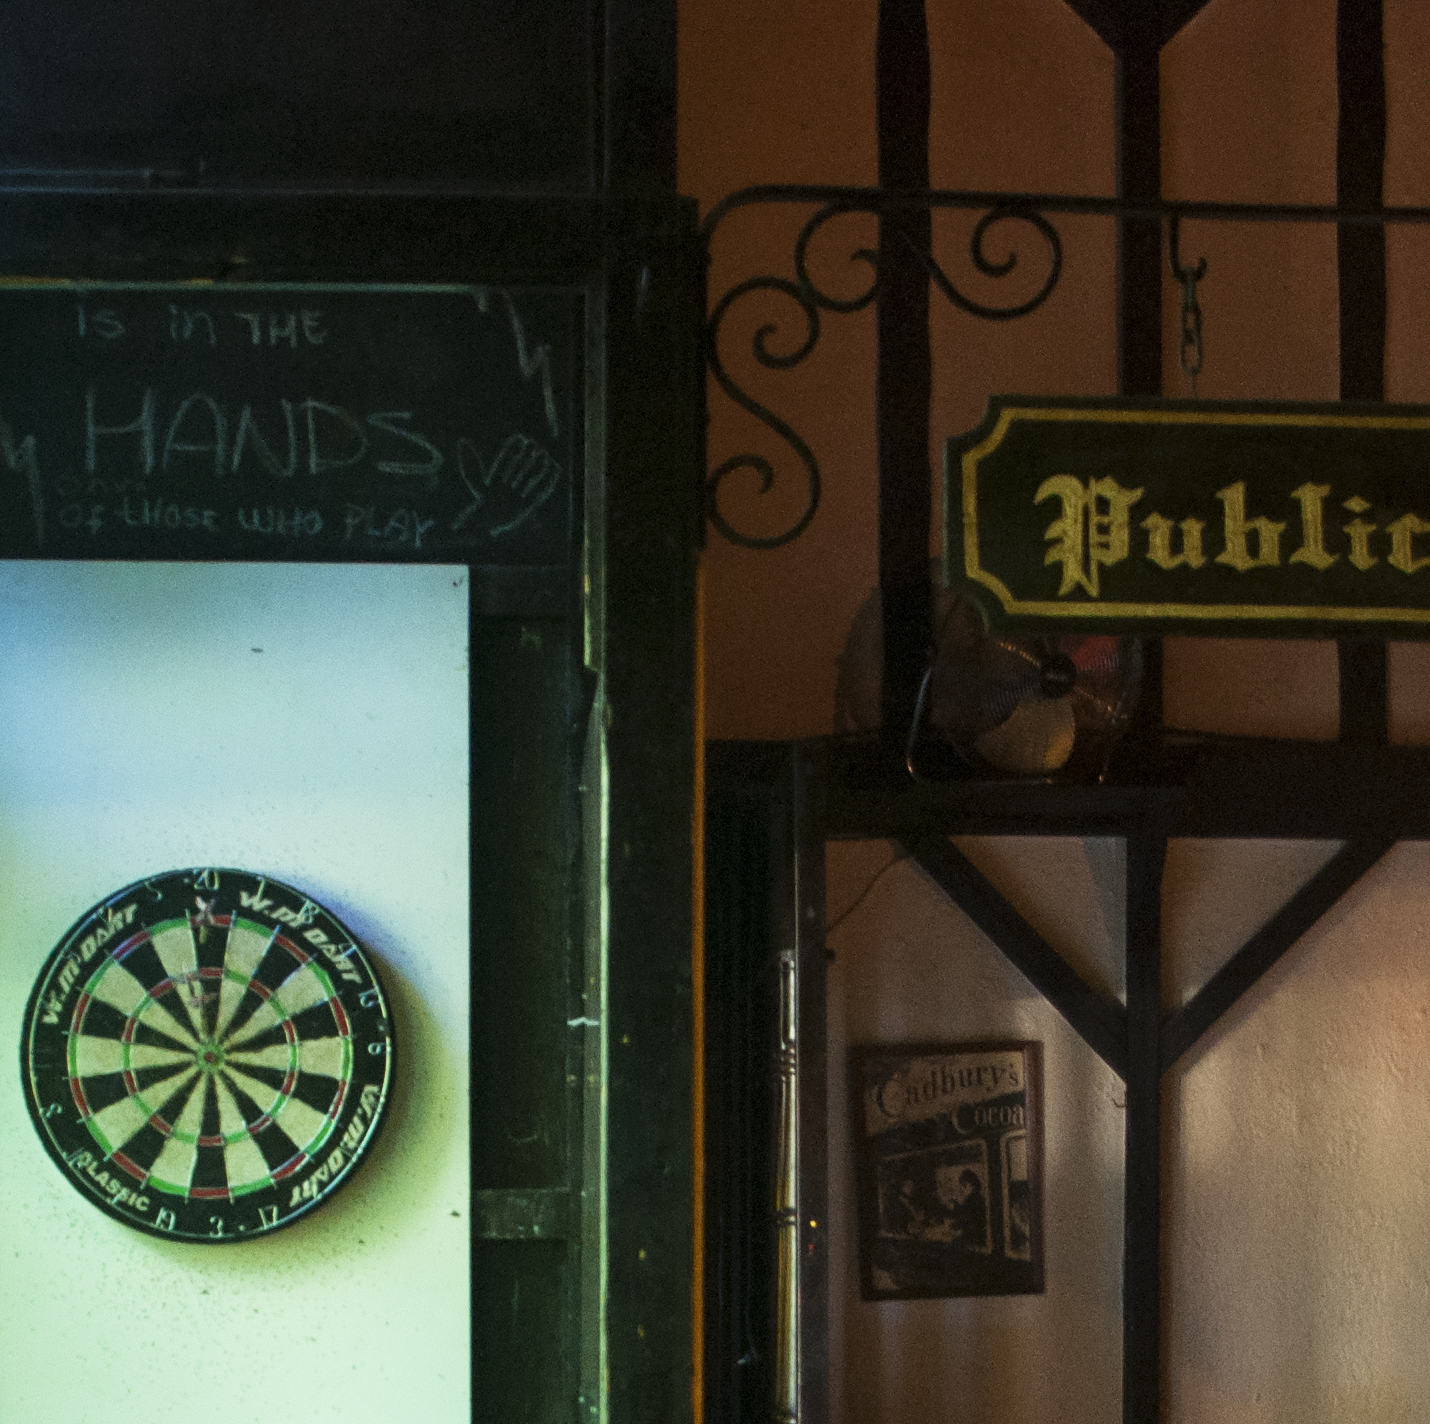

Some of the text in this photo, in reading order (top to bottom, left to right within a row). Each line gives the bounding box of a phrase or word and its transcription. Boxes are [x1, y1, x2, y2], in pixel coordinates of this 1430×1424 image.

[233, 309, 329, 349] THE
[82, 387, 446, 478] HANDS
[951, 1102, 1026, 1135] Cocoa
